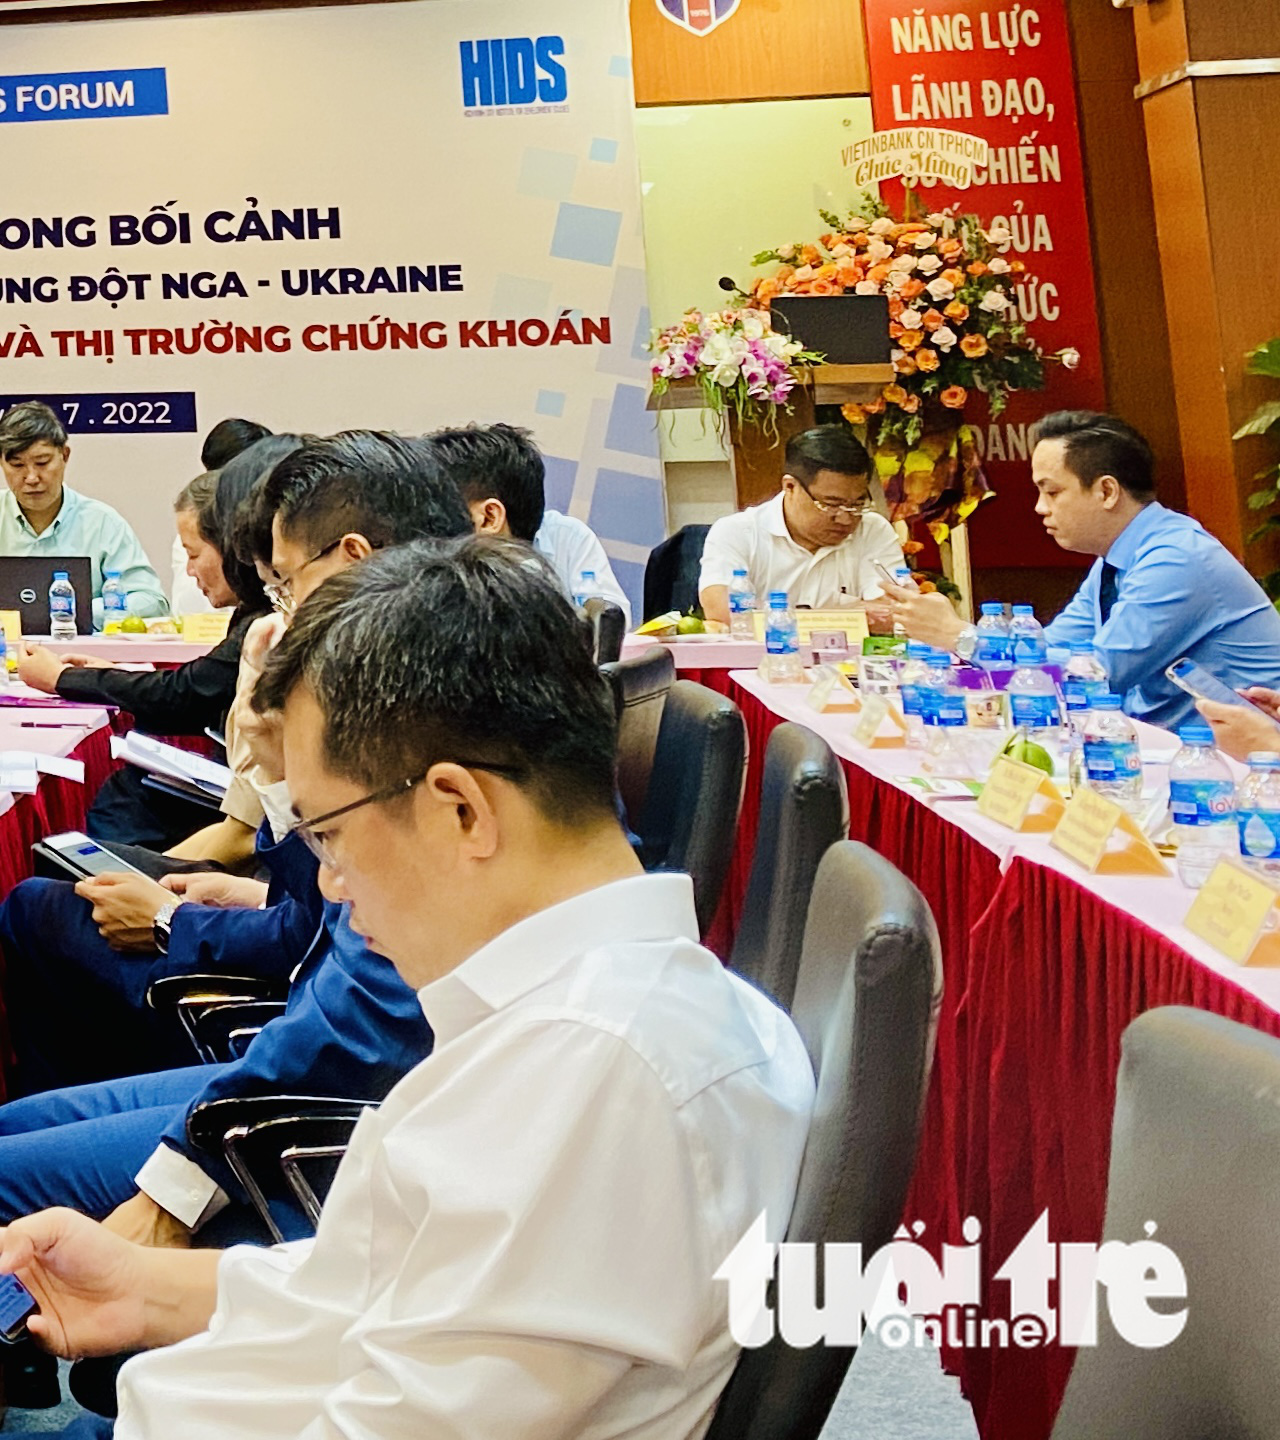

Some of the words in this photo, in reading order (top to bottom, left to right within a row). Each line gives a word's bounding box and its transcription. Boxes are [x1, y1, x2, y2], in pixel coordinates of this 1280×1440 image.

[890, 8, 974, 54] NĂNG
[980, 3, 1041, 56] LỰC
[459, 36, 567, 107] HIDS
[16, 80, 134, 112] FORUM
[891, 73, 973, 121] LÃNH
[982, 77, 1055, 124] ĐẠO,
[841, 130, 914, 167] VIETINBANK
[917, 130, 934, 150] CN
[939, 132, 985, 160] TPHCM
[855, 154, 902, 187] Chúc
[904, 150, 969, 186] Mừng
[109, 200, 191, 246] BỐI
[203, 196, 341, 242] CẢNH
[67, 267, 152, 309] ĐỘT
[161, 270, 248, 300] NGA
[281, 264, 464, 297] UKRAINE
[50, 328, 115, 364] THỊ
[122, 316, 292, 357] TRƯỜNG
[300, 311, 448, 352] CHỨNG
[458, 309, 611, 348] KHOÁN
[62, 404, 80, 425] 7
[103, 402, 173, 425] 2022
